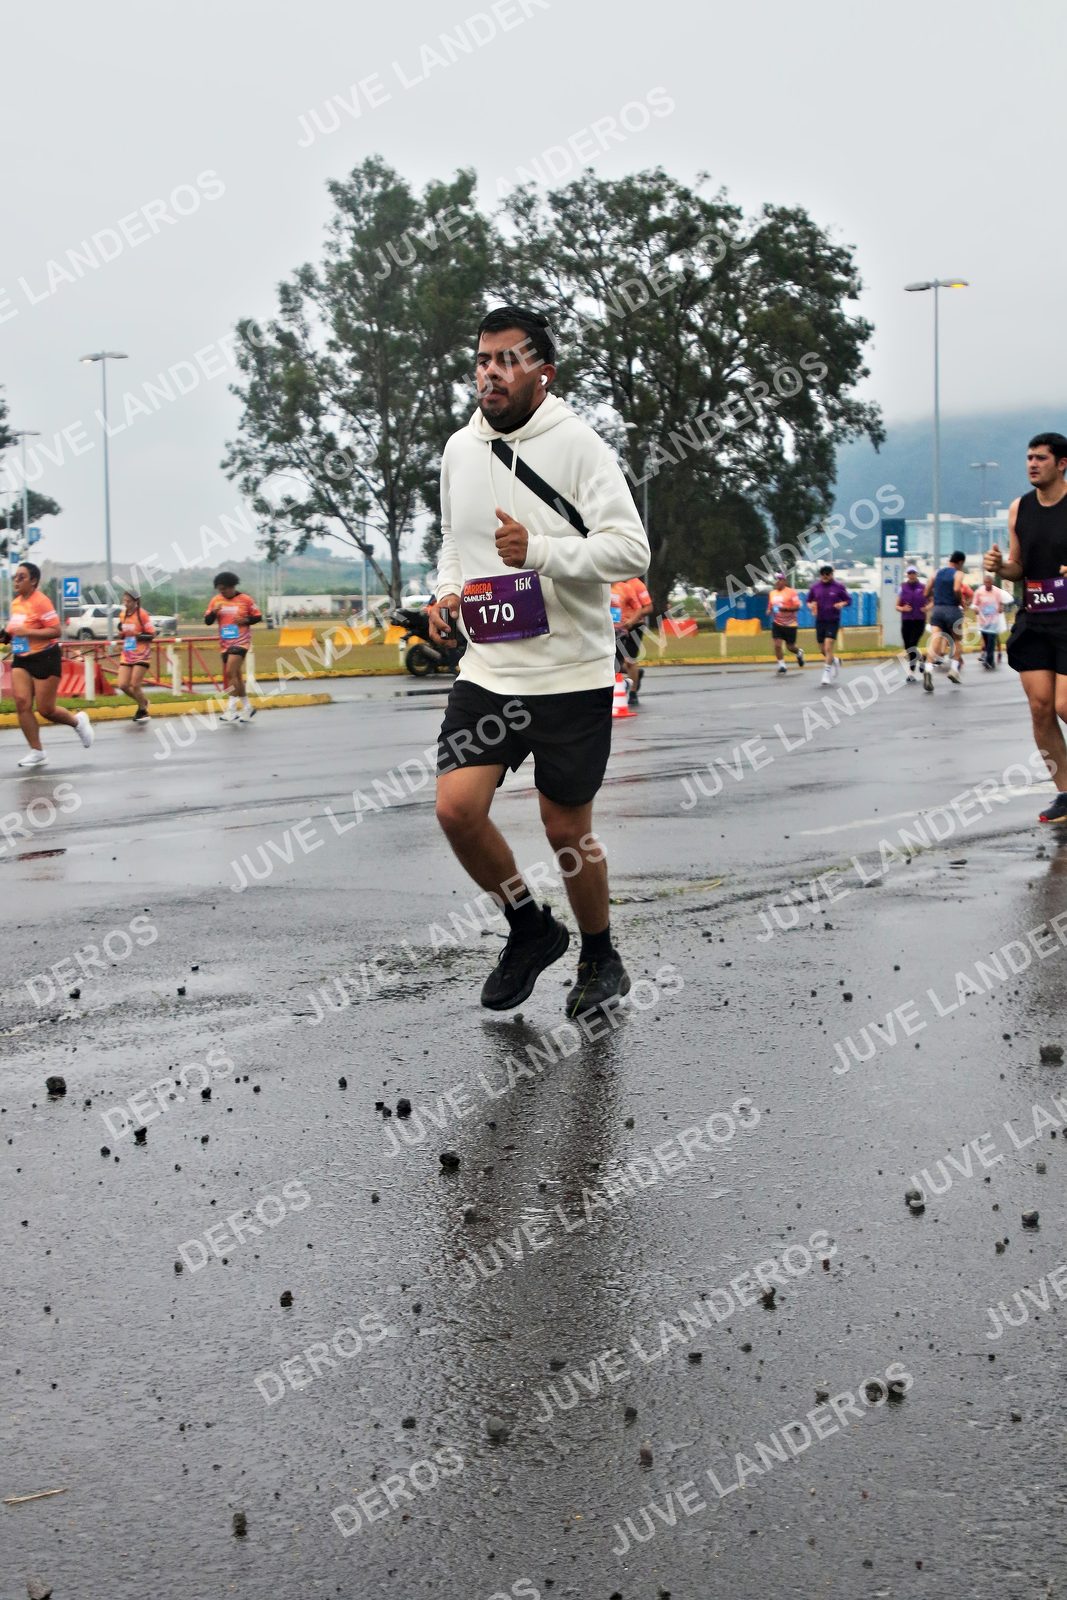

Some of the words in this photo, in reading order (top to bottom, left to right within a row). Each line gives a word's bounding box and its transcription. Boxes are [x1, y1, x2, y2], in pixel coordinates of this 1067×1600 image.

[886, 535, 898, 552] E
[514, 576, 532, 591] 15K
[1033, 592, 1055, 604] 246
[478, 603, 514, 624] 170
